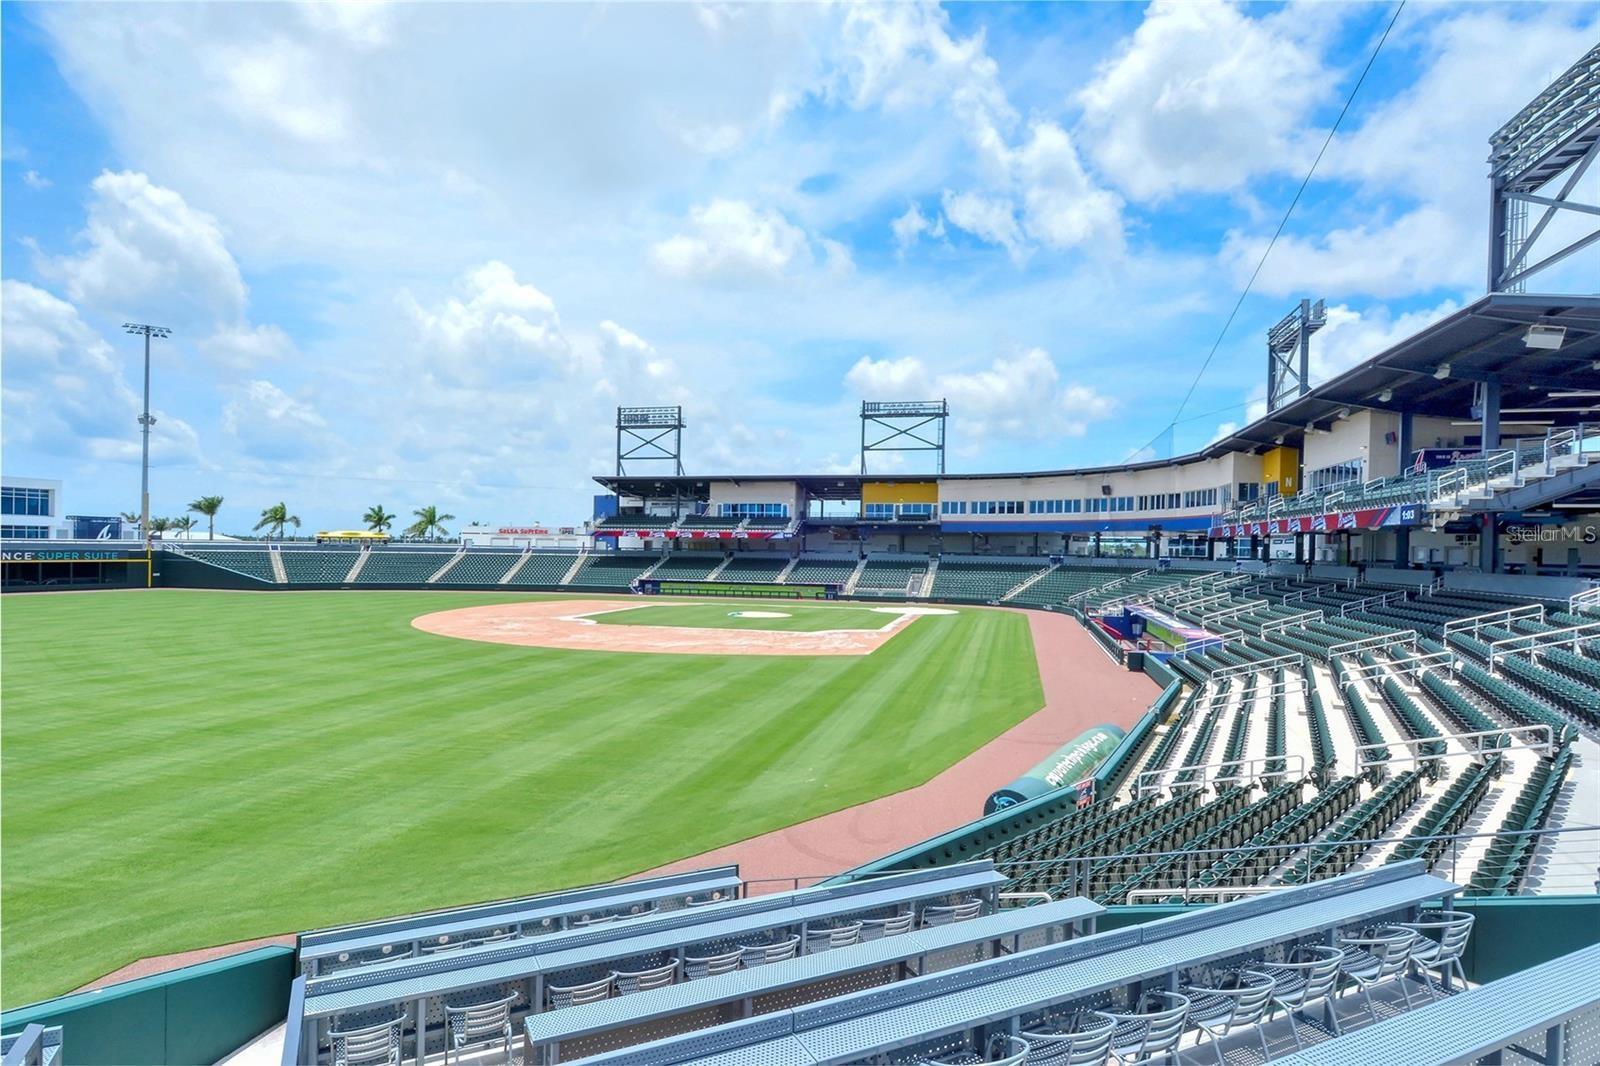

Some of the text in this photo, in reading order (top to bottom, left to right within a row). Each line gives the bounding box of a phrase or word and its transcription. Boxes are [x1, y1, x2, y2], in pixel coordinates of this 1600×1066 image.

[1402, 510, 1415, 520] 1:03
[38, 552, 80, 560] SUPER
[84, 552, 118, 560] SUITE
